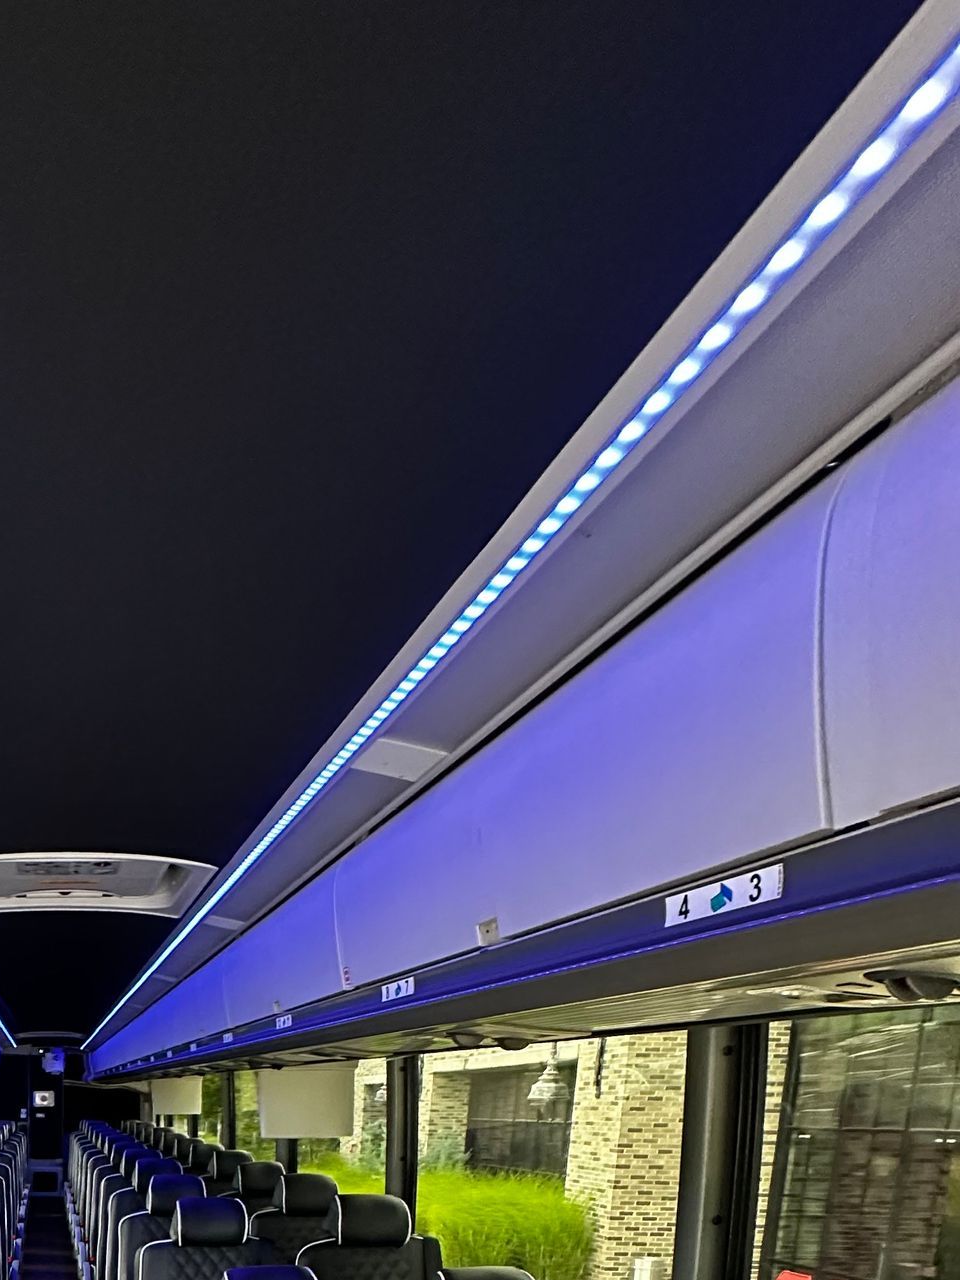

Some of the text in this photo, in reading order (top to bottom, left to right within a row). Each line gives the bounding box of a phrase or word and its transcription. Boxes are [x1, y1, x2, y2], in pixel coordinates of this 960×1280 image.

[678, 894, 690, 920] 4
[749, 873, 761, 902] 3
[404, 979, 409, 995] 7
